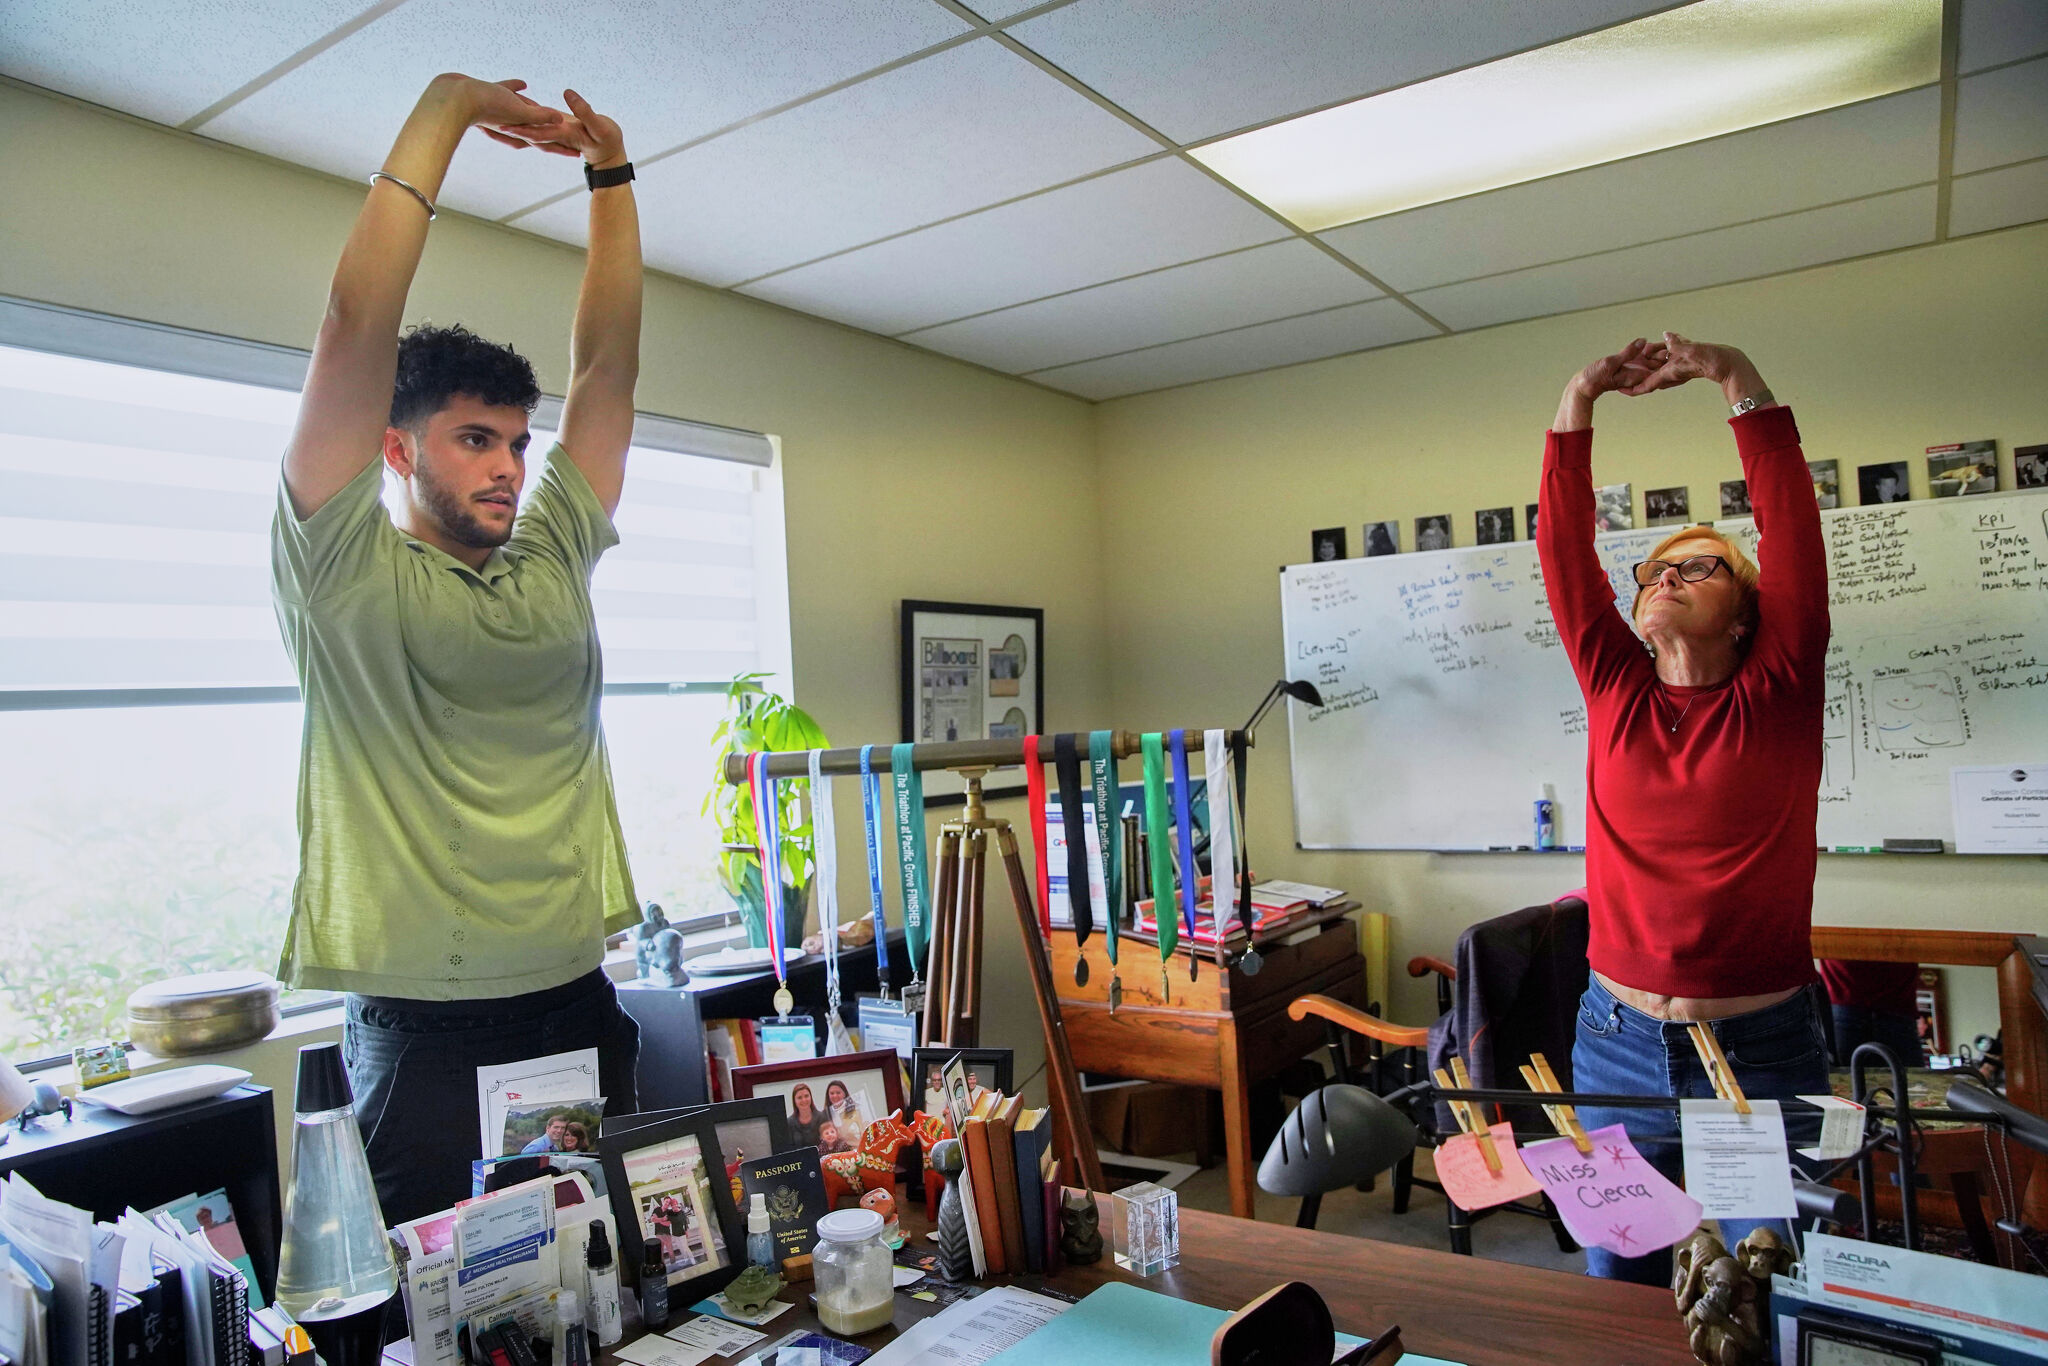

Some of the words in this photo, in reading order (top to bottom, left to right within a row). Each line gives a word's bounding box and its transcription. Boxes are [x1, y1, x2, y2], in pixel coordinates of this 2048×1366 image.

[924, 641, 978, 665] Billboard
[1095, 758, 1106, 774] The
[896, 773, 908, 788] The
[1096, 775, 1108, 812] Triathlon
[898, 789, 910, 824] Triathlon
[1098, 813, 1108, 822] at
[901, 825, 911, 834] at
[1099, 823, 1109, 850] Pacific
[902, 835, 914, 862] Pacific
[905, 863, 916, 887] Grove
[906, 888, 920, 928] FINISHER
[755, 1161, 802, 1179] PASSPORT
[1540, 1162, 1597, 1186] Miss
[1576, 1181, 1651, 1210] Cierra
[776, 1229, 792, 1238] United
[787, 1234, 807, 1242] America
[416, 1261, 443, 1275] Official
[1836, 1251, 1891, 1269] ACURA
[488, 1308, 517, 1324] California
